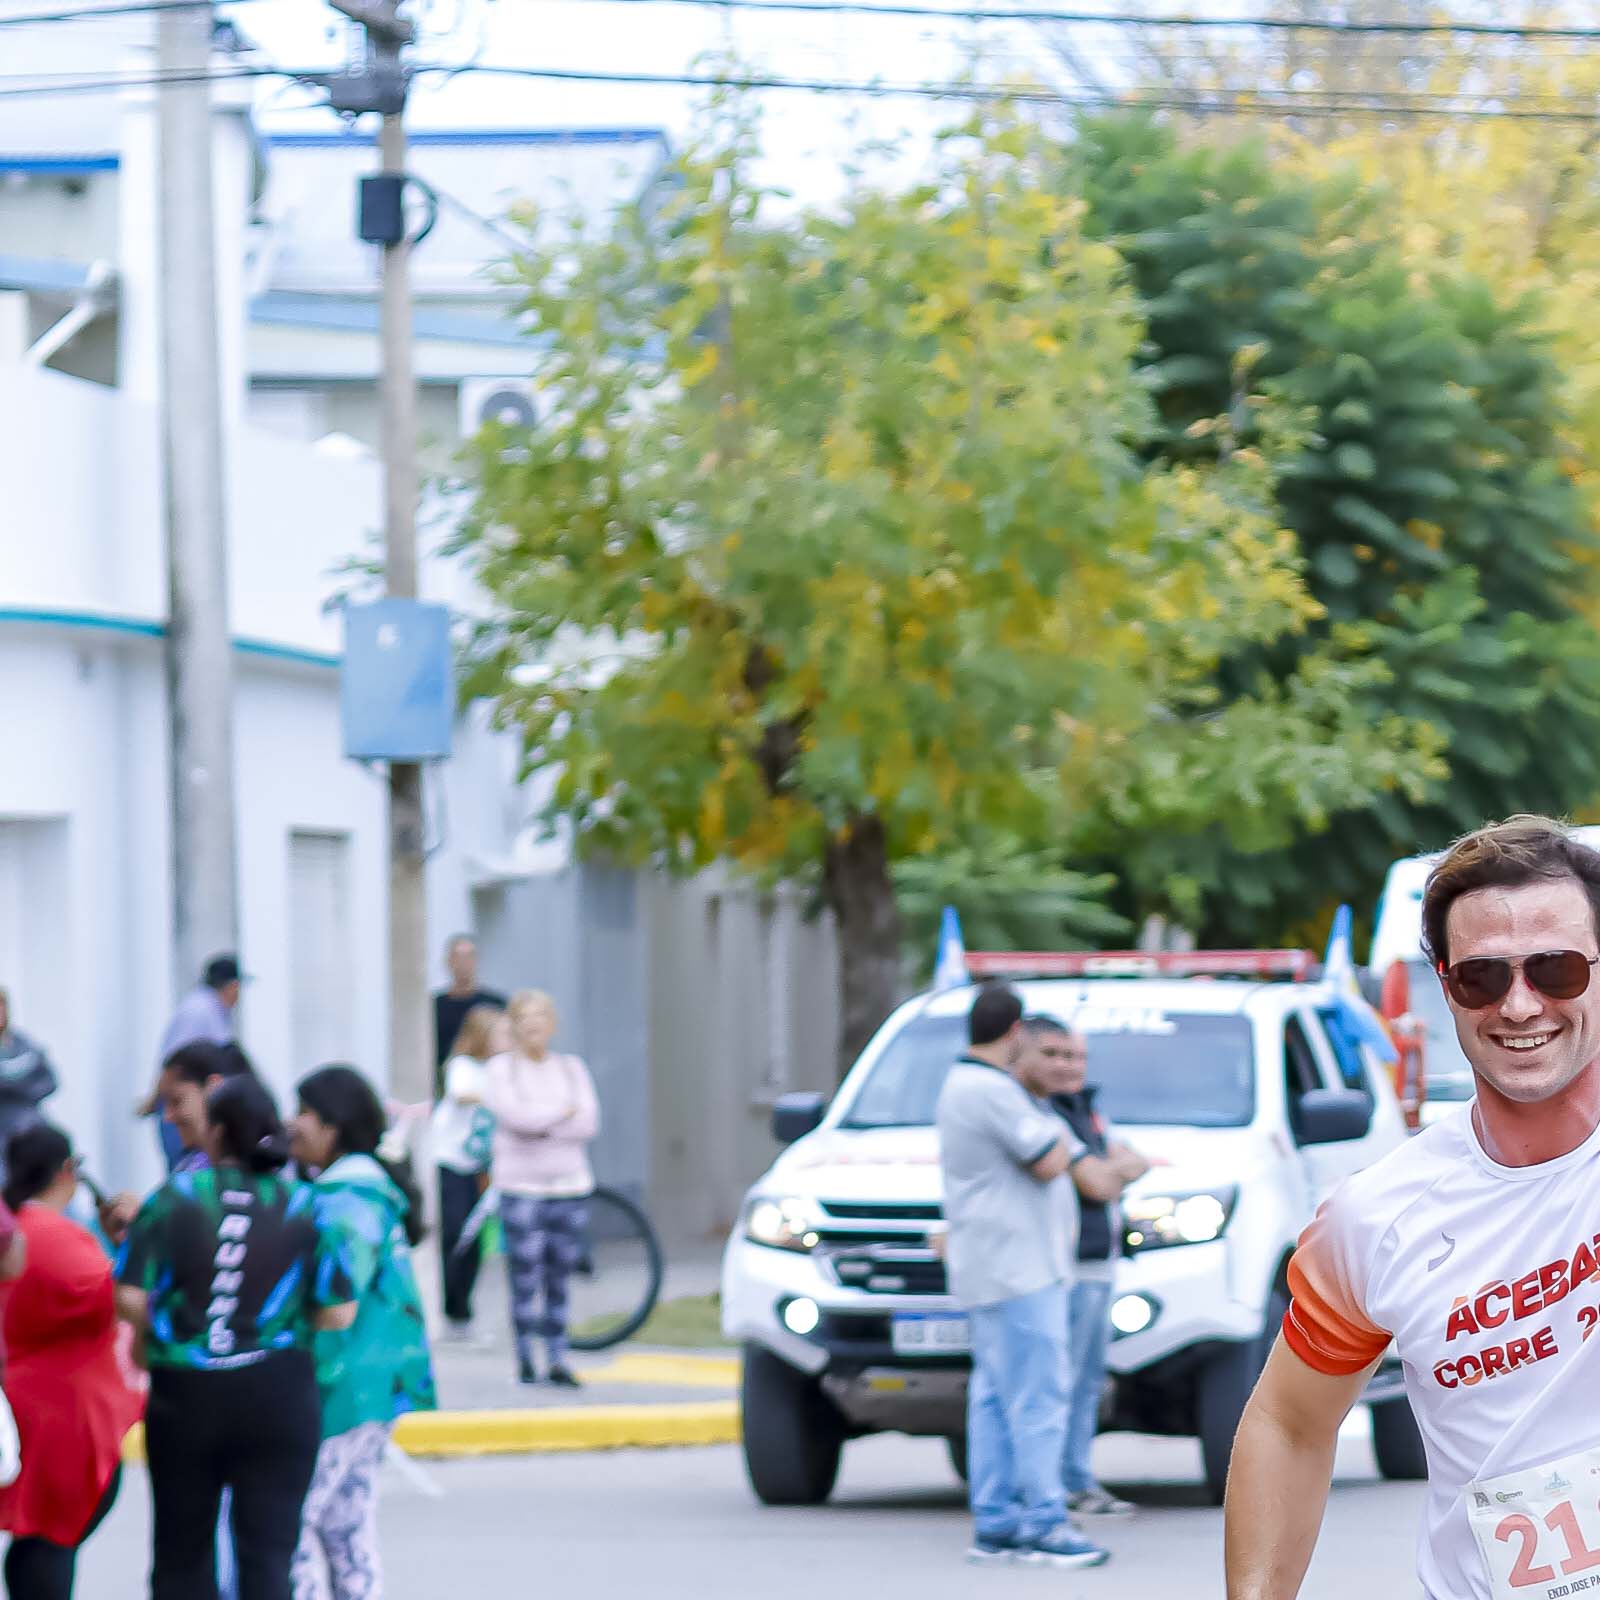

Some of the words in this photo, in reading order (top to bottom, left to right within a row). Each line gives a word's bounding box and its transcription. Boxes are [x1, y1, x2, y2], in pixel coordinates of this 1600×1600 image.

[1432, 1326, 1559, 1389] CORRE
[1547, 1584, 1569, 1600] ENZO
[1570, 1578, 1591, 1594] JOSE
